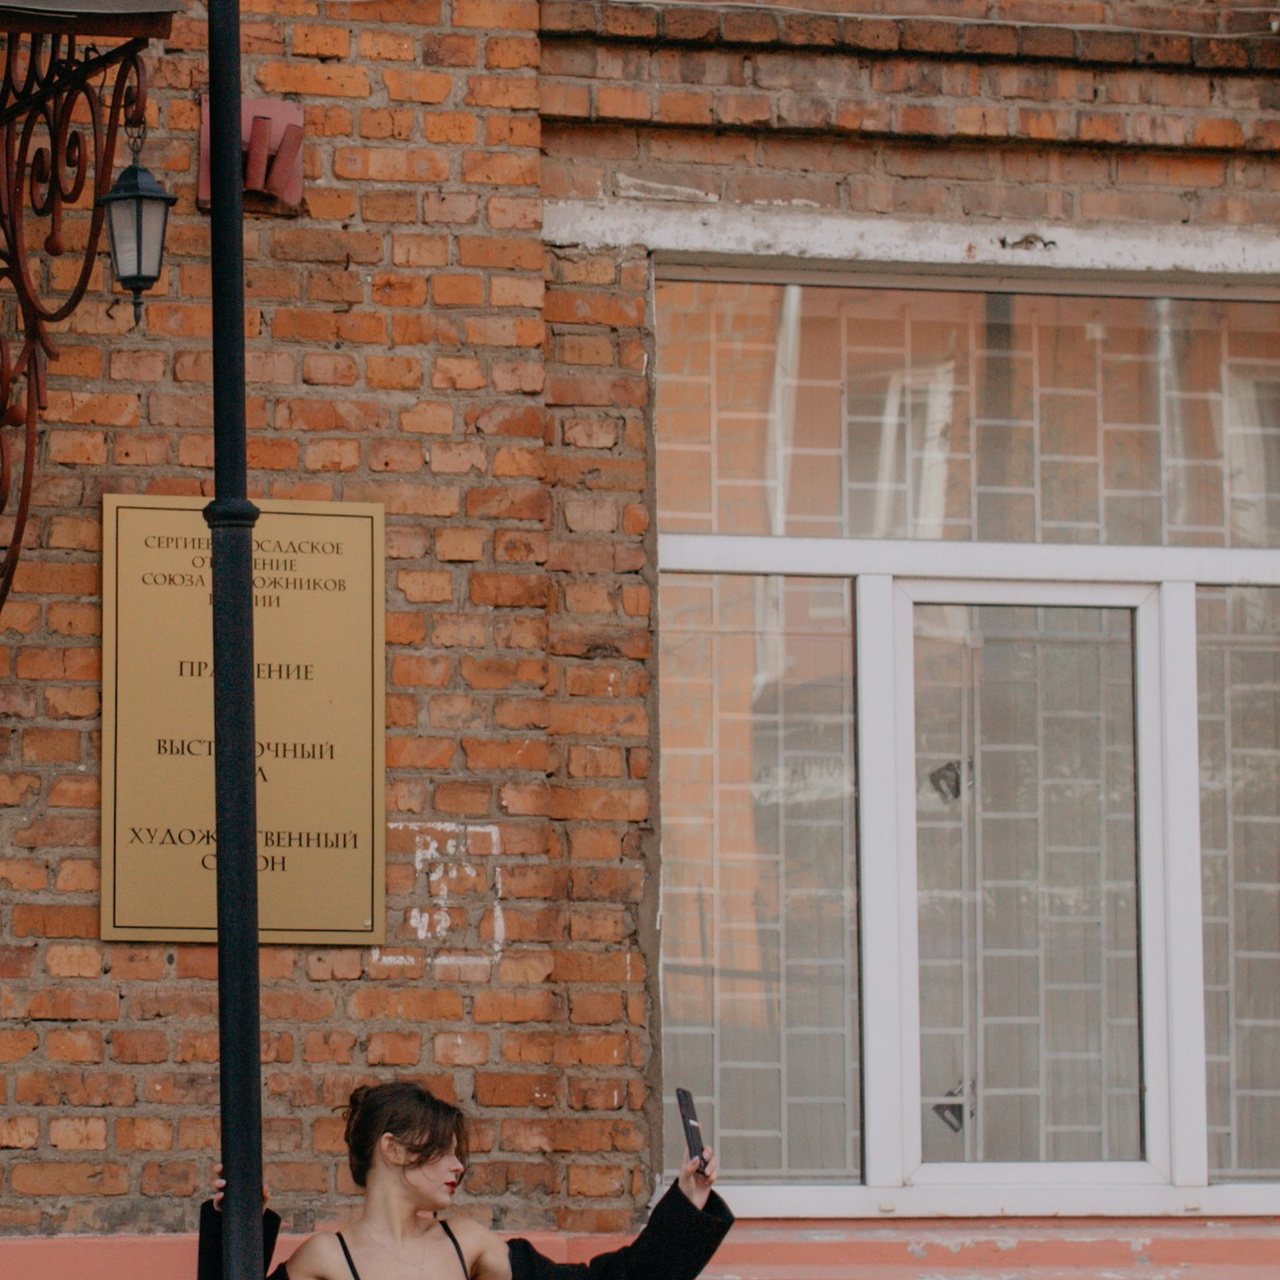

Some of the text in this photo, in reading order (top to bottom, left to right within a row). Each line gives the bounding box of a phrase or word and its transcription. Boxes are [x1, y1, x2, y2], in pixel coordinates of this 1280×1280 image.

[141, 572, 347, 592] СОЮЗА ОЖНИКОВ
[178, 660, 314, 681] ПРЕНИЕ
[156, 738, 335, 760] ВЫСТОЧНЫЙ
[129, 827, 359, 849] ХУДОЖВЕННЫЙ
[201, 853, 287, 872] СОН
